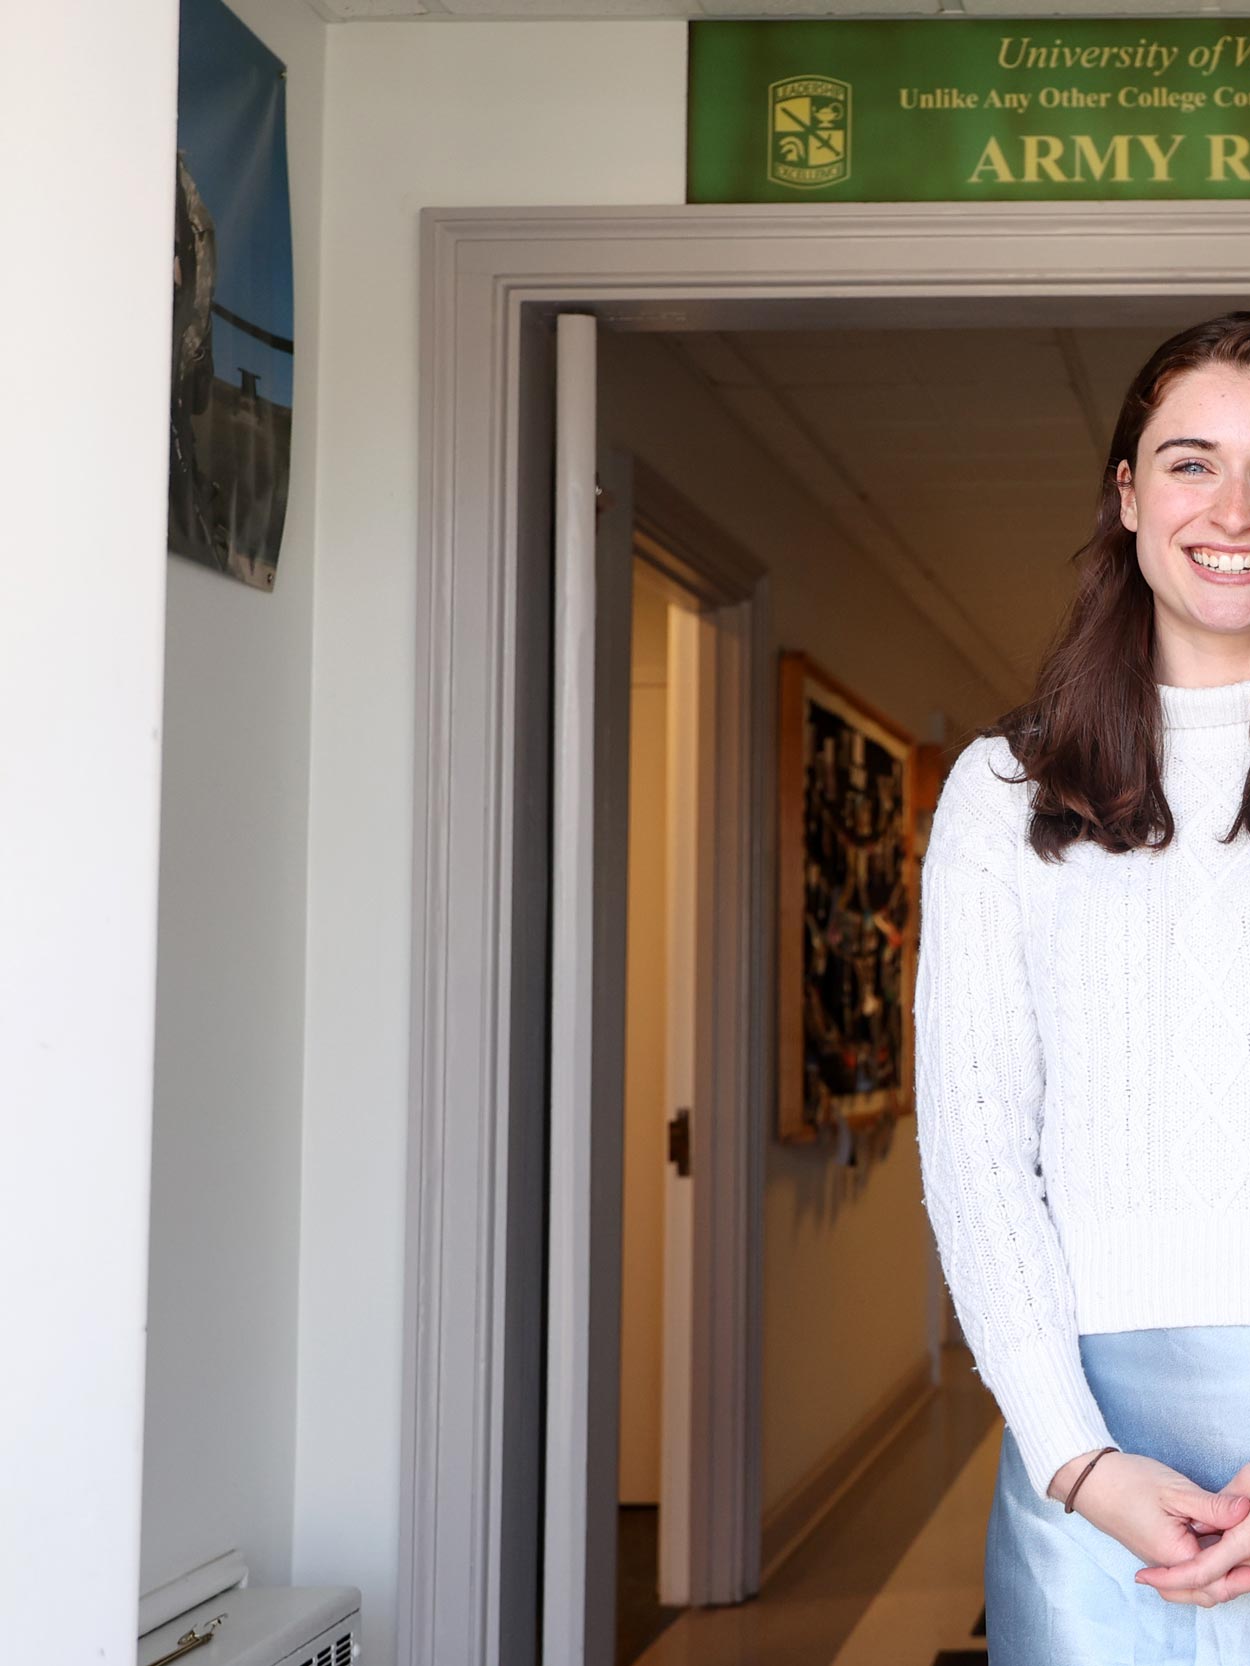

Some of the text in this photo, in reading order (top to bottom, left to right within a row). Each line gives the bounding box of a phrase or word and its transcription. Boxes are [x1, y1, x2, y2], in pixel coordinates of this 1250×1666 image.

[997, 37, 1179, 76] University
[1188, 35, 1232, 76] of
[899, 88, 979, 109] Unlike
[983, 89, 1031, 113] Any
[1039, 87, 1111, 108] Other
[1118, 86, 1207, 112] College
[967, 134, 1185, 183] ARMY
